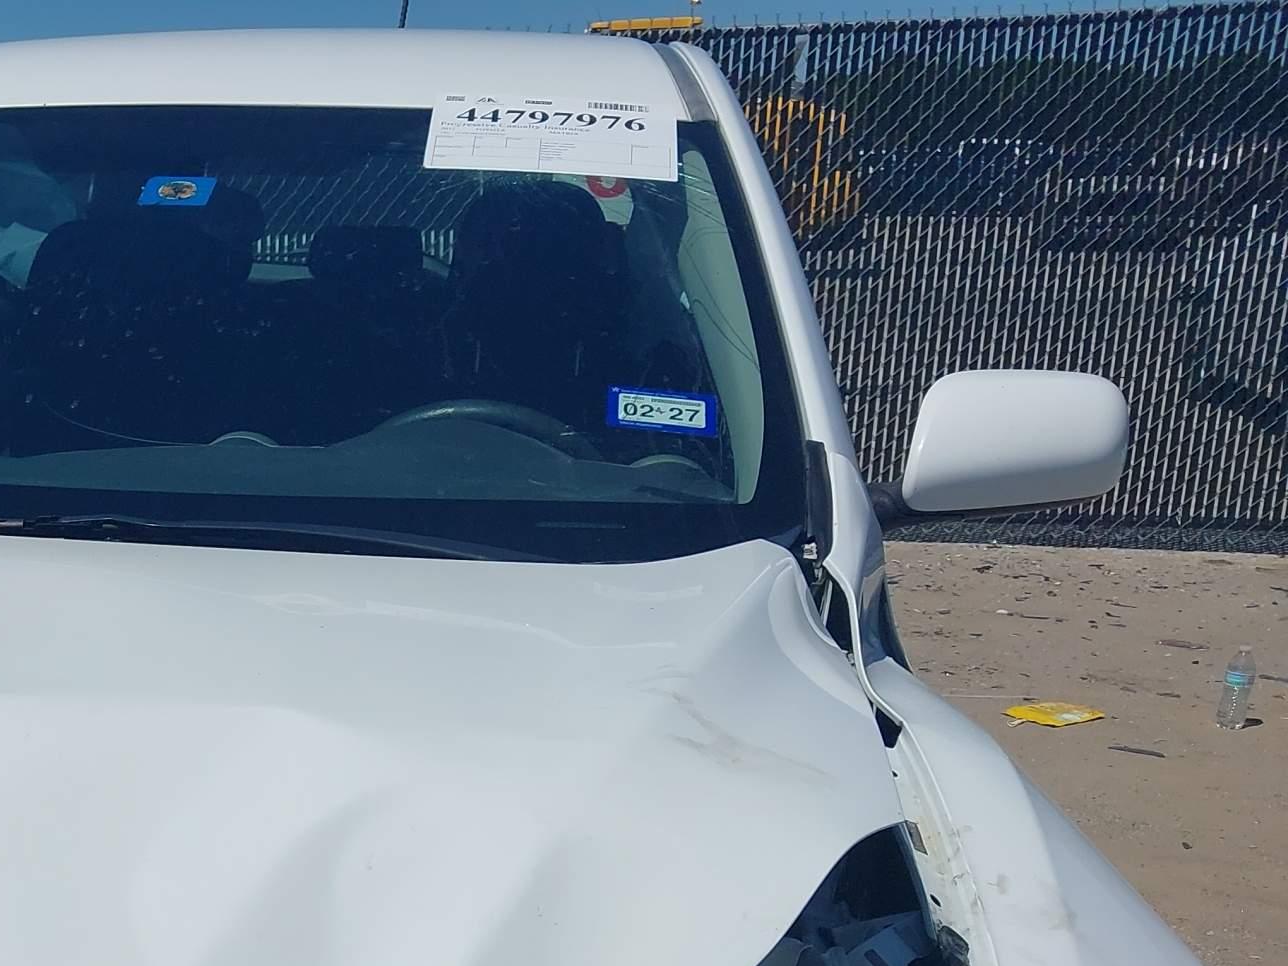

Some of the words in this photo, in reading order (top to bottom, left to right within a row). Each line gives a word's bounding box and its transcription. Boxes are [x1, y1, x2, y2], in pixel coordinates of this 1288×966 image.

[456, 107, 647, 132] 44797976
[623, 402, 655, 418] 02
[668, 407, 701, 422] 27
